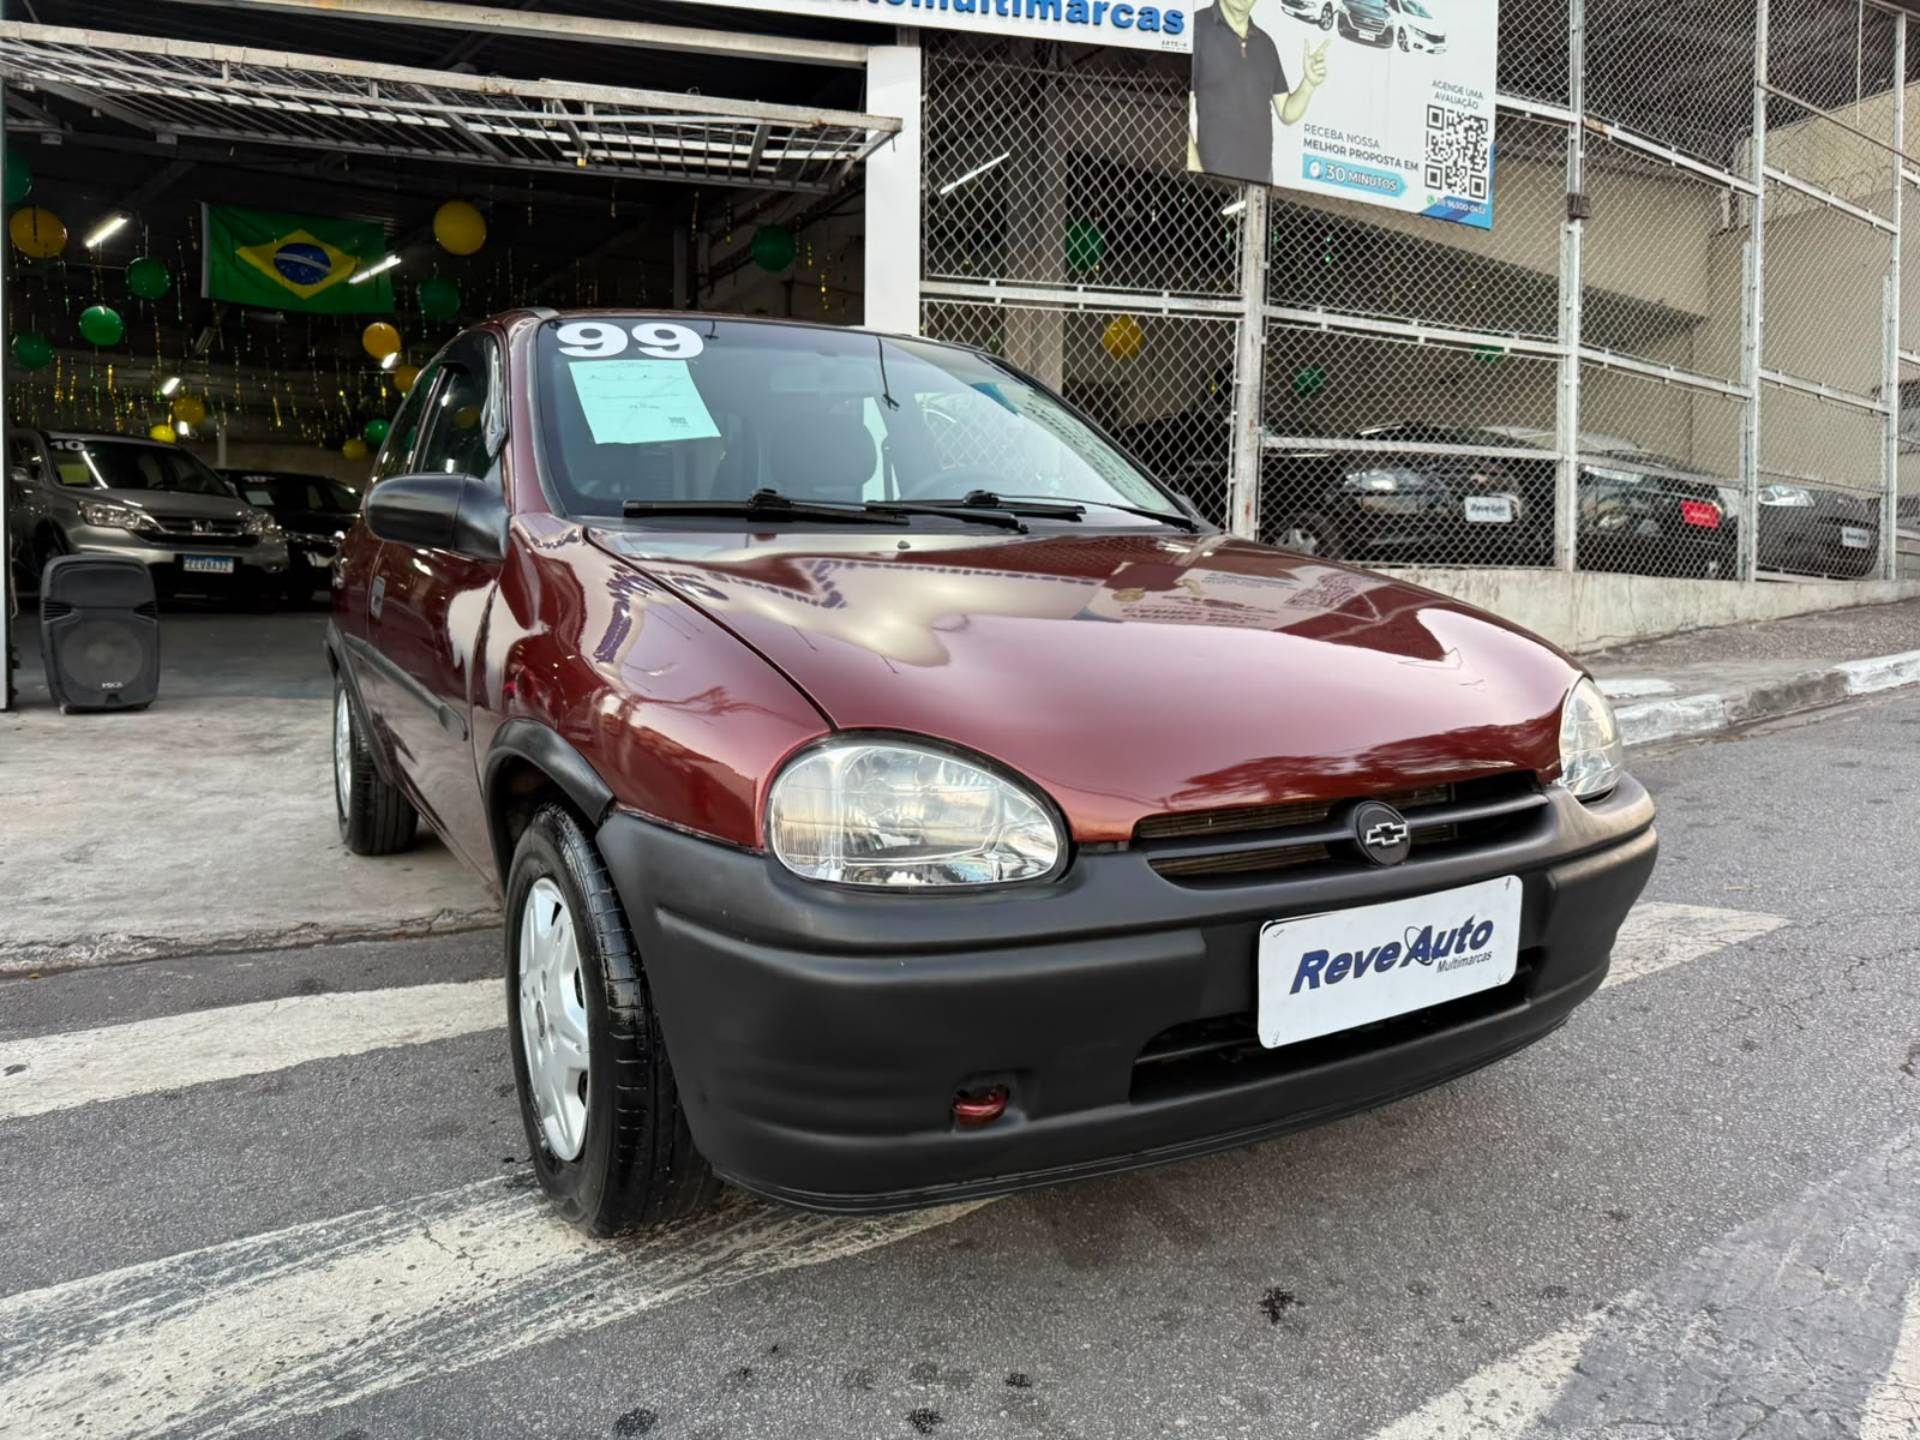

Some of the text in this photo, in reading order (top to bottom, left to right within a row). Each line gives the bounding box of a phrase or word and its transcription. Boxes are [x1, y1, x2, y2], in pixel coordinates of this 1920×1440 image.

[1432, 80, 1484, 100] AGENDE UMA
[1303, 124, 1380, 149] RECEBA NOSSA
[1303, 138, 1419, 171] MELHOR PROPOSTA EM
[1326, 164, 1398, 192] 30 MINUTOS
[556, 322, 704, 359] 99
[50, 440, 85, 450] 10
[1436, 951, 1493, 974] Multimarcas
